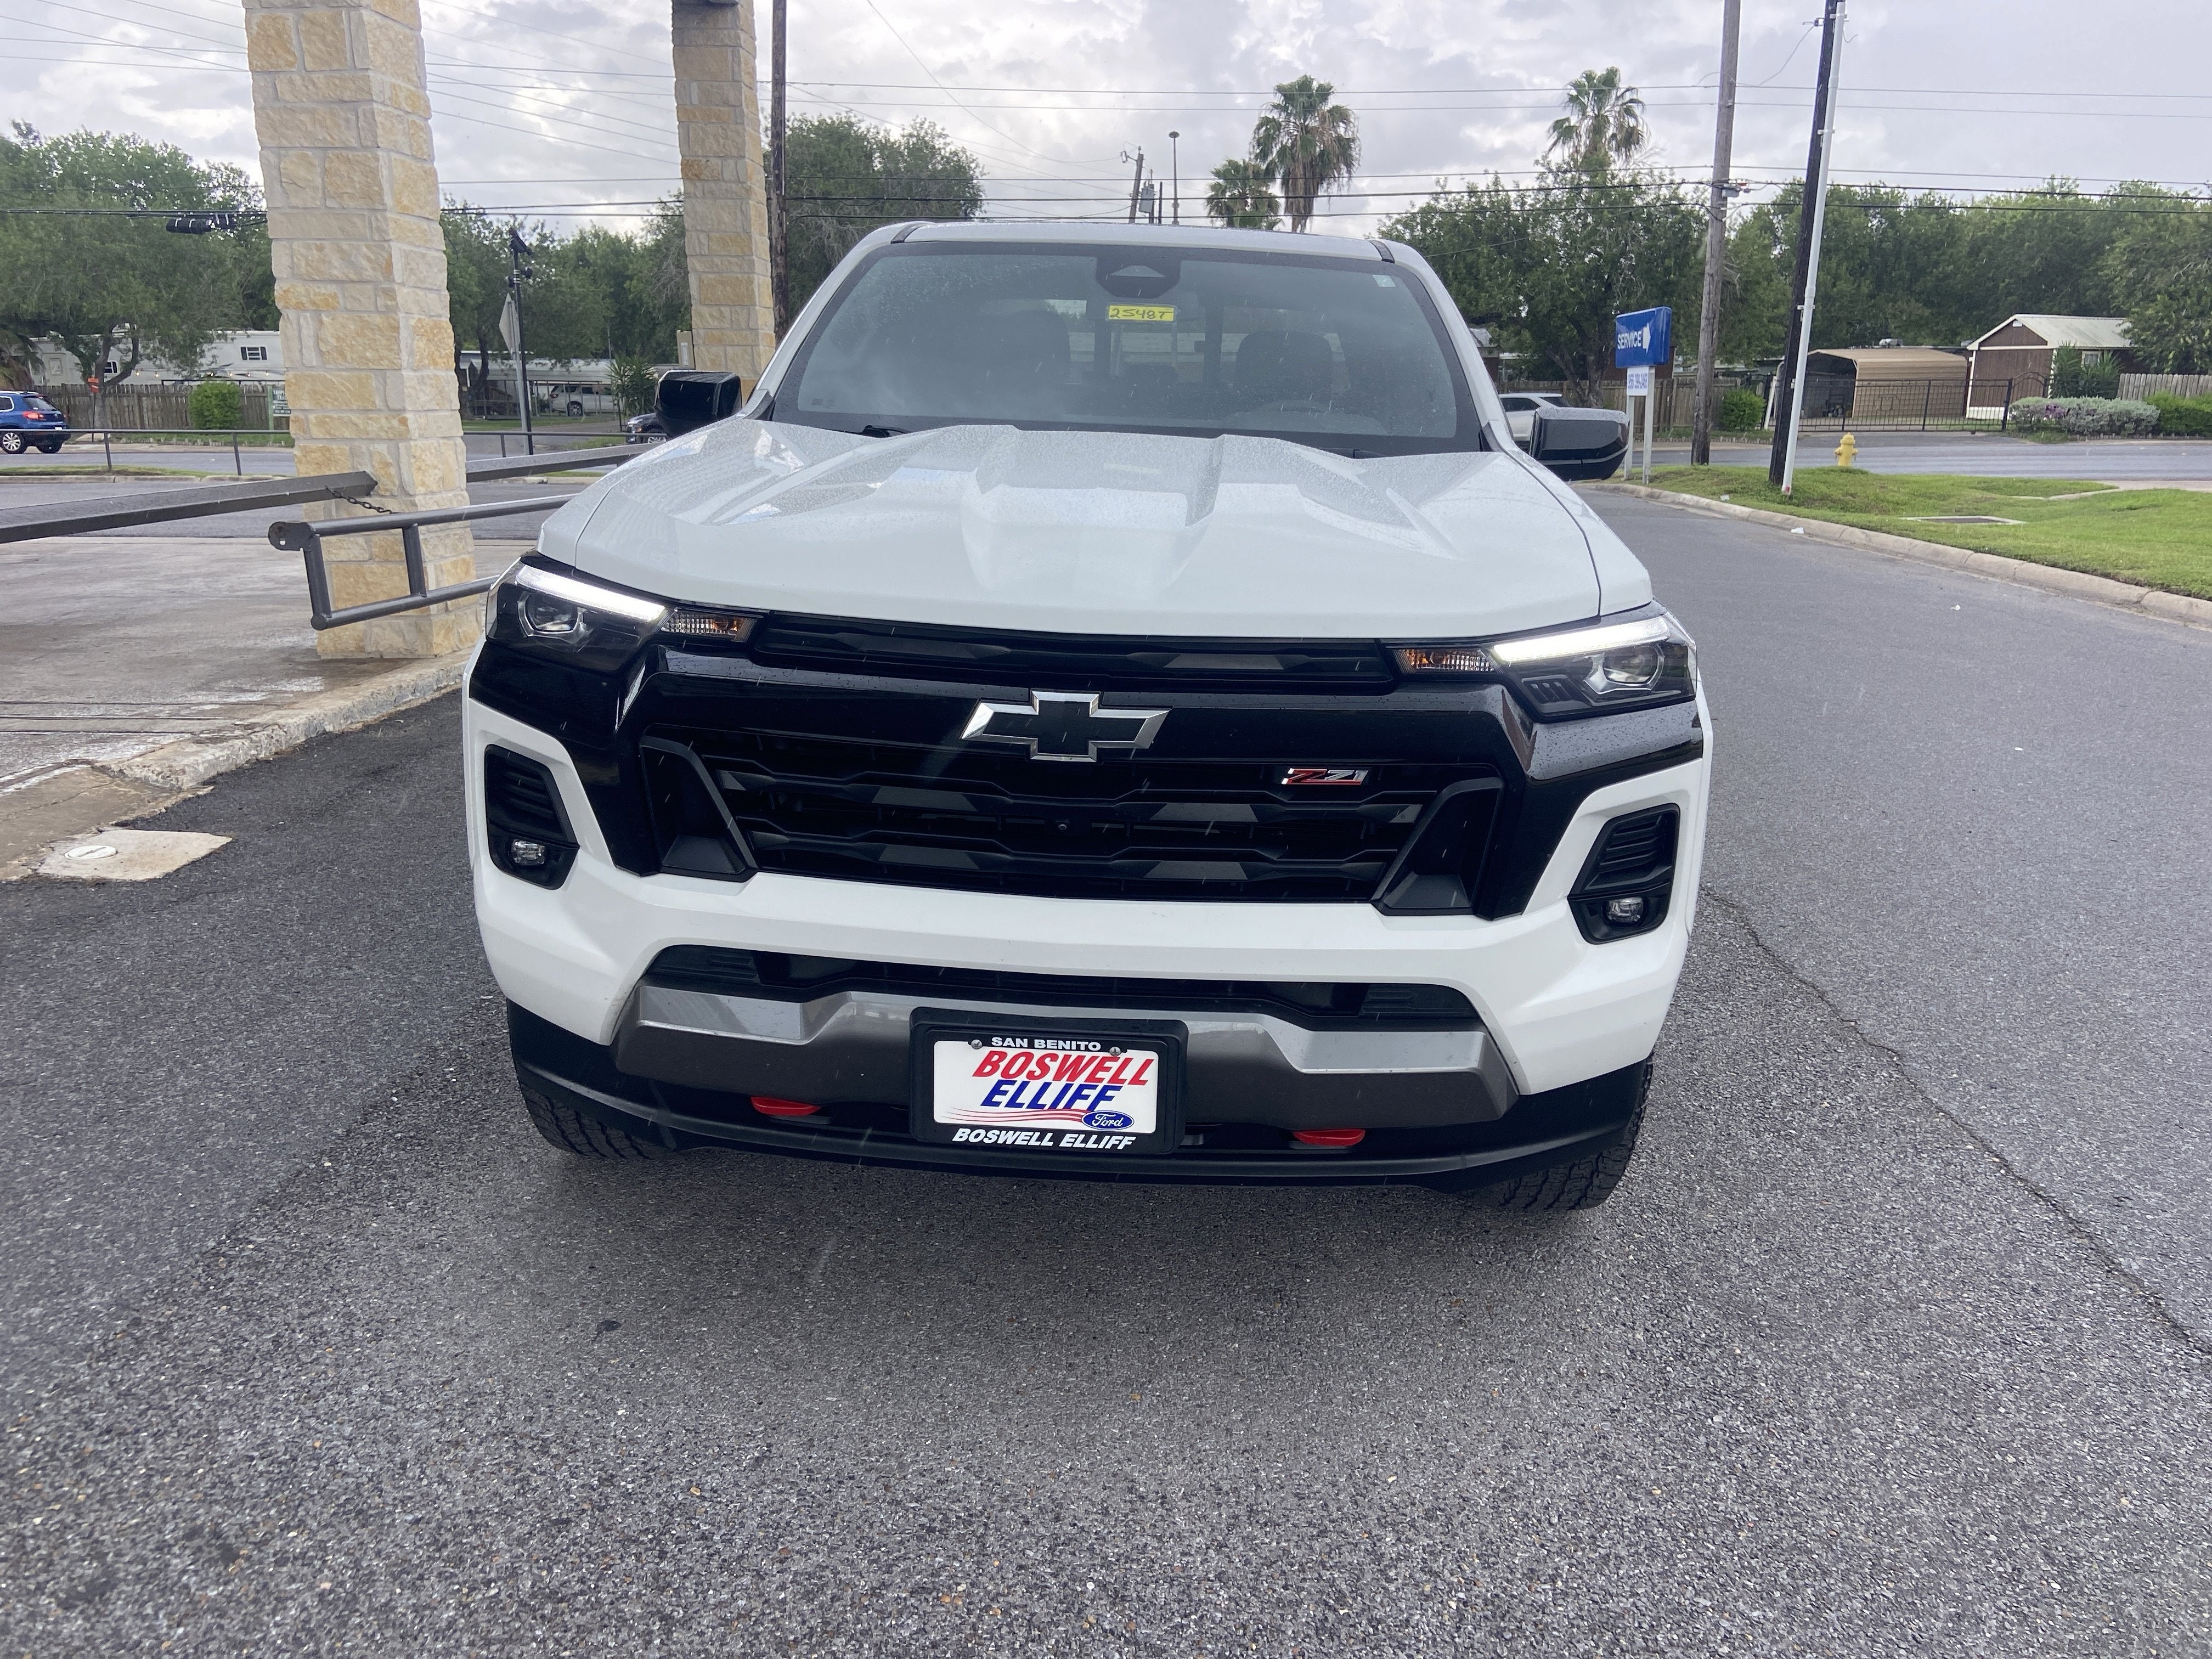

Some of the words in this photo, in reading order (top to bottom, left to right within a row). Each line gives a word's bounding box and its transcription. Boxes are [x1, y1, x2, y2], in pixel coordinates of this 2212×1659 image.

[1617, 331, 1642, 349] SERVICE
[1281, 768, 1369, 786] Z71
[991, 1037, 1028, 1047] SAN
[1034, 1039, 1101, 1051] BENITO
[972, 1051, 1154, 1086] BOSWELL
[980, 1079, 1124, 1112] ELLIFF
[1091, 1113, 1124, 1128] Ford
[952, 1128, 1054, 1147] BOSWELL
[1059, 1133, 1137, 1150] ELLIFF
